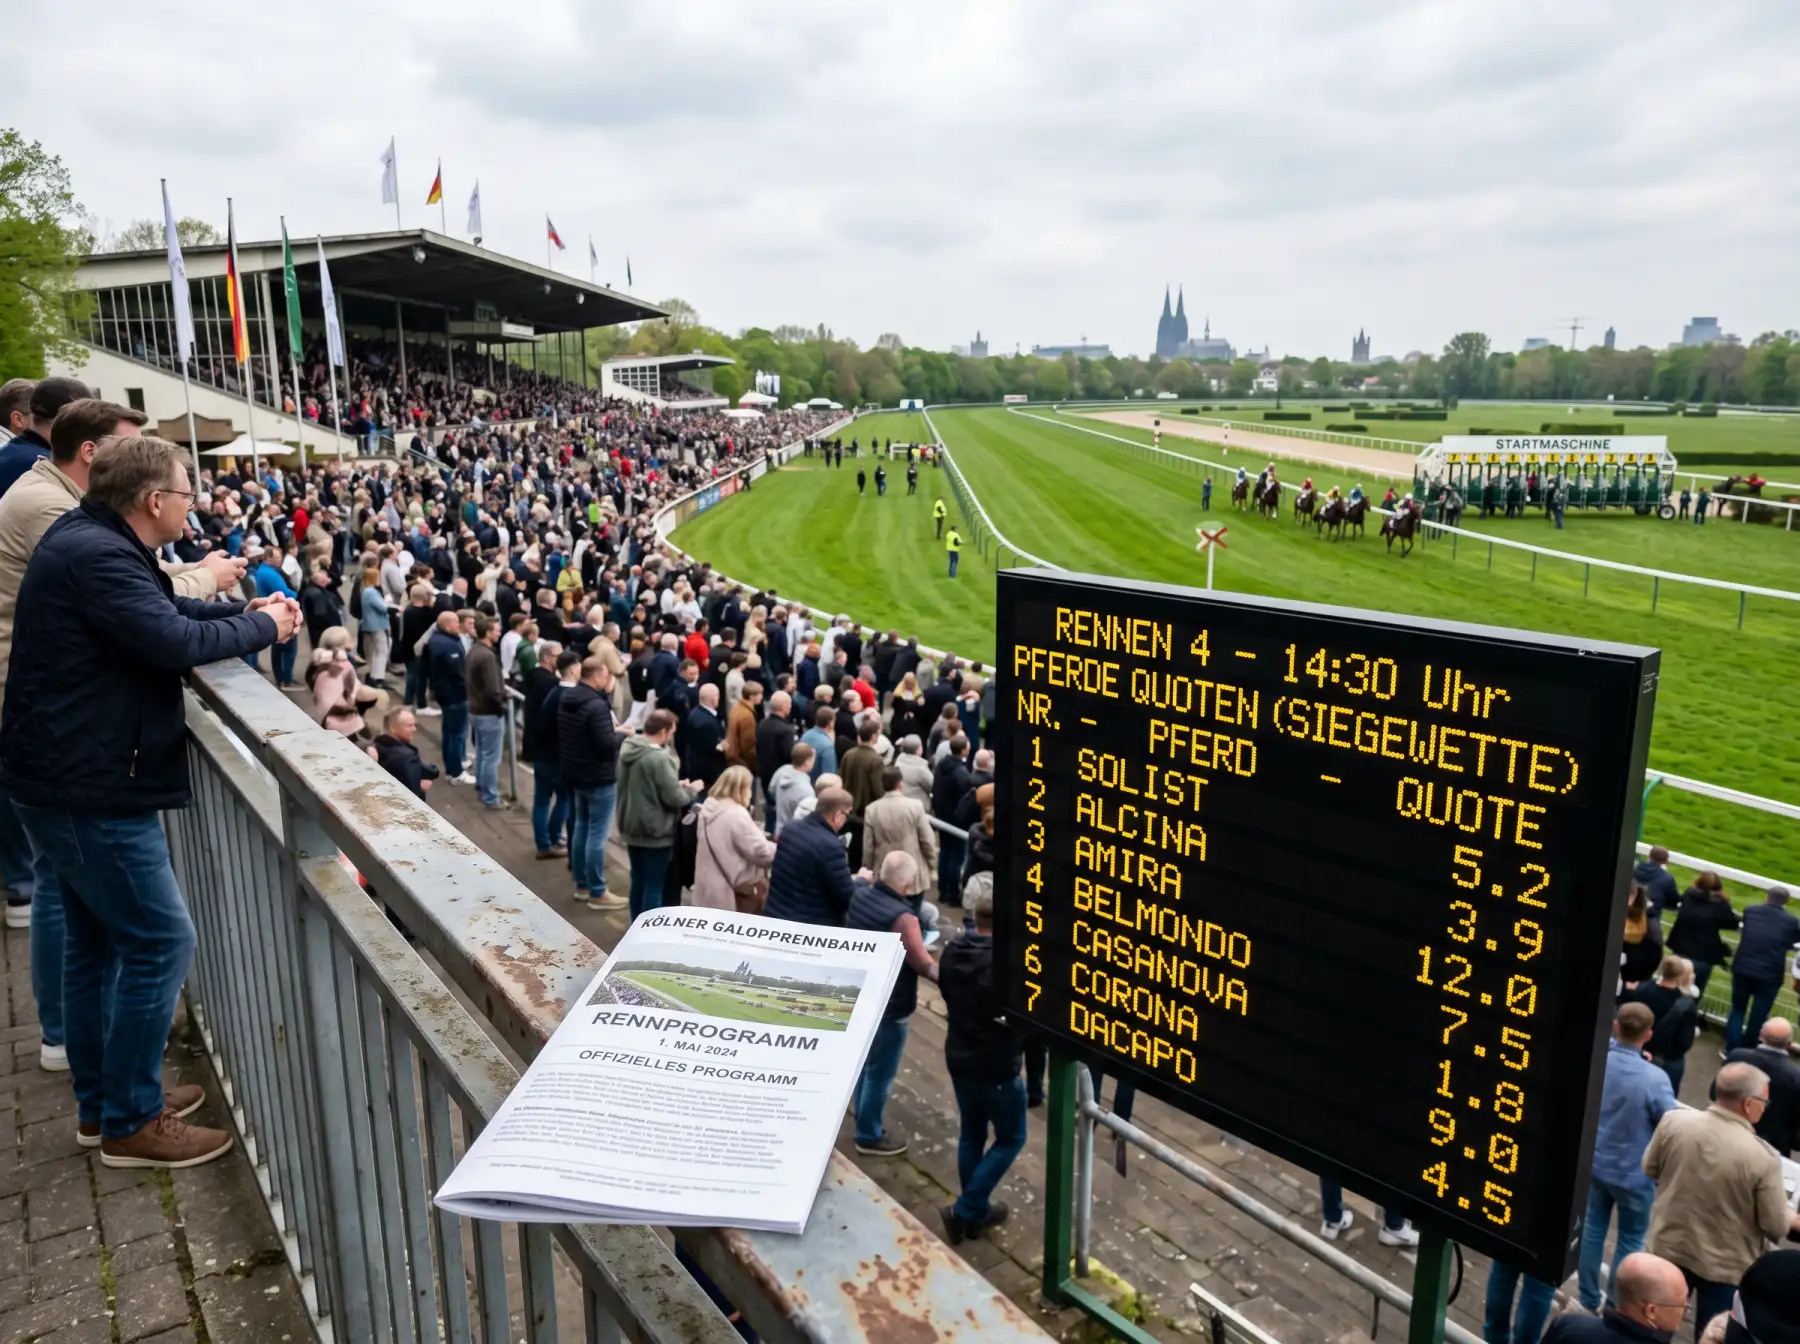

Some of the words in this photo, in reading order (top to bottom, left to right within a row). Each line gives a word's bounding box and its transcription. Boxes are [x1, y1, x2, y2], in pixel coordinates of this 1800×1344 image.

[1496, 439, 1611, 450] STARTMASCHINE
[1015, 645, 1120, 698] PFERDE
[1132, 668, 1258, 729] QUOTEN
[1274, 696, 1579, 794] (SIEGEWETTE)
[1056, 607, 1172, 660] RENNEN
[1191, 630, 1210, 666] 4
[1284, 644, 1397, 700] 14:30
[1423, 665, 1511, 718] Uhr
[1018, 689, 1060, 730] NR.
[1150, 719, 1256, 777] PFERD
[1397, 777, 1546, 849] QUOTE
[1032, 737, 1042, 767] 1
[1078, 748, 1208, 811] SOLIST
[1452, 845, 1550, 908] 5.2
[641, 915, 708, 930] KÖLNER
[713, 922, 877, 953] GALOPPRENNBAHN
[1028, 778, 1045, 810] 2
[1077, 793, 1206, 862] ALCINA
[1448, 900, 1543, 961] 3.9
[1028, 819, 1044, 852] 3
[1076, 836, 1181, 899] AMIRA
[1417, 946, 1537, 1017] 12.0
[592, 1012, 819, 1051] RENNPROGRAMM
[1026, 901, 1042, 934] 5
[1073, 920, 1247, 1015] CASANOVA
[1437, 1060, 1524, 1123] 1.8
[1027, 863, 1043, 893] 4
[1074, 877, 1251, 968] BELMONDO
[1441, 1005, 1531, 1070] 7.5
[579, 1050, 688, 1073] OFFIZIELLES
[692, 1065, 798, 1086] PROGRAMM
[659, 1038, 669, 1048] 1.
[673, 1041, 701, 1051] MAI
[705, 1045, 738, 1058] 2024
[1025, 944, 1041, 974] 6
[1072, 962, 1198, 1041] CORONA
[1429, 1108, 1518, 1174] 9.0
[1025, 981, 1041, 1011] 7
[1071, 1002, 1196, 1083] DACAPO
[1422, 1162, 1512, 1225] 4.5
